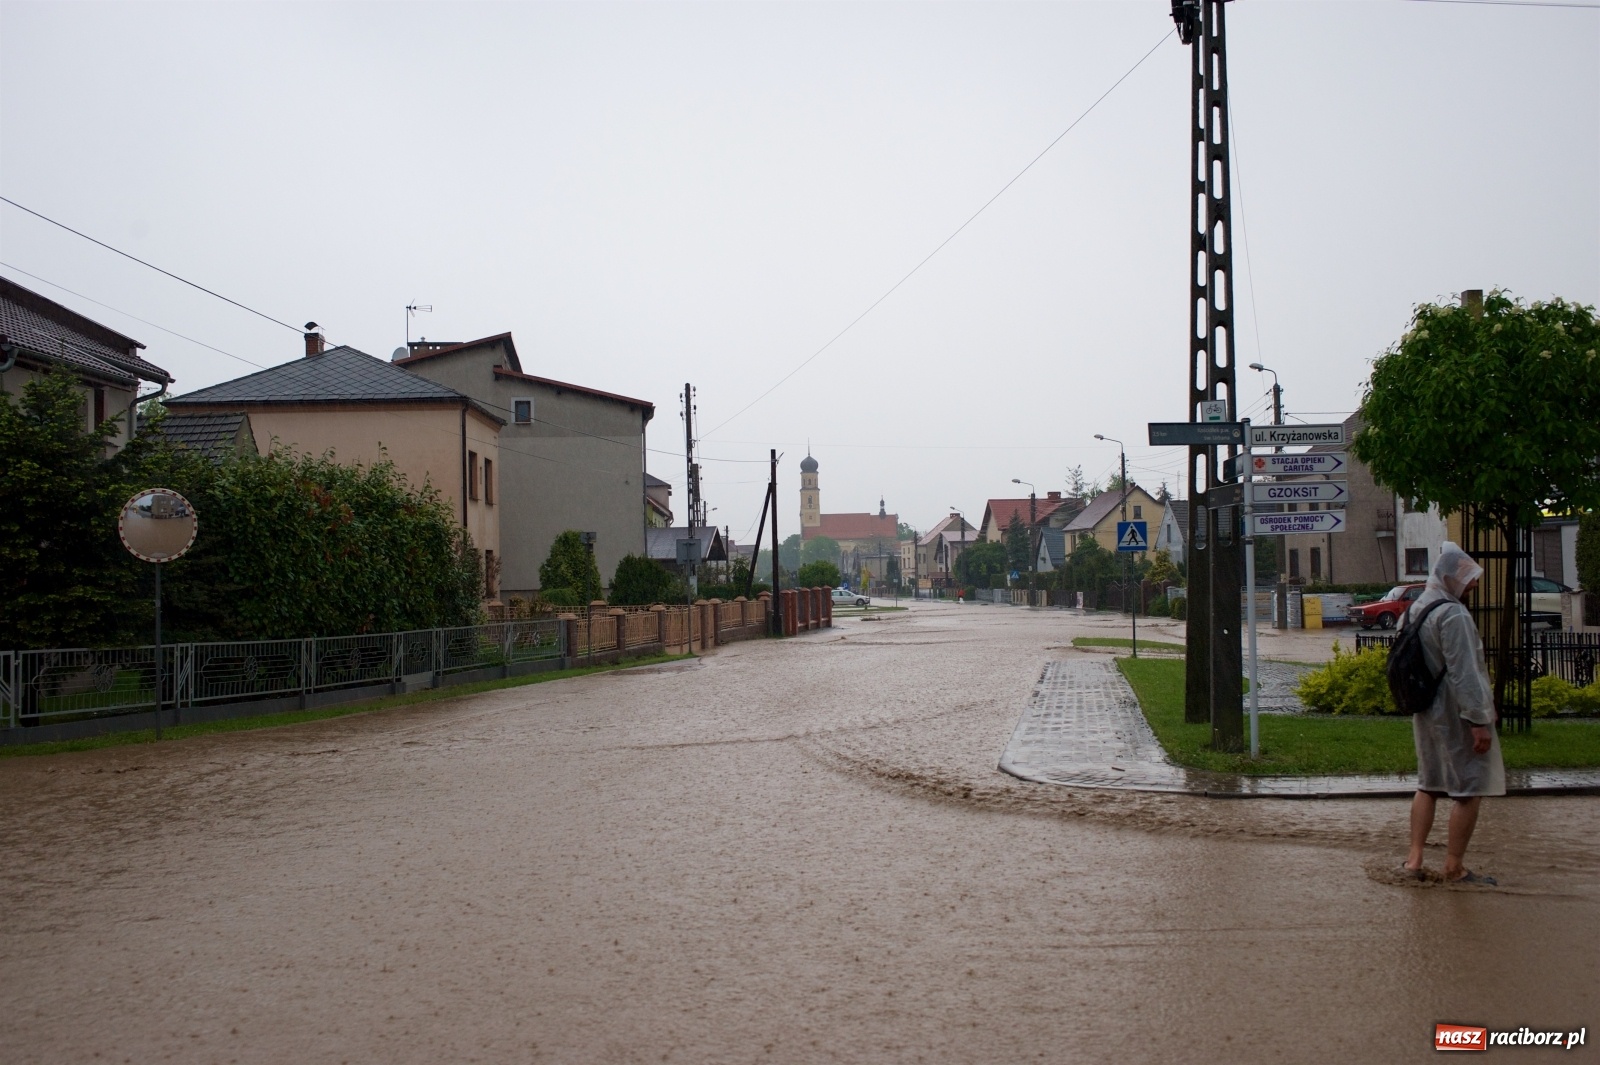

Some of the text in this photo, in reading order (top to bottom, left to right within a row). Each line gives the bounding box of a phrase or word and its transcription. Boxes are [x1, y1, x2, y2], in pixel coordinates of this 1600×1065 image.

[1255, 430, 1339, 444] ul. Krzyżanowska
[1271, 456, 1325, 465] STACJA OPIEKI
[1283, 464, 1314, 472] CARITAS
[1268, 486, 1319, 498] GZOKSiT
[1260, 515, 1324, 525] OŚRODEK POMOCY
[1270, 523, 1314, 532] SPOŁECZNEJ
